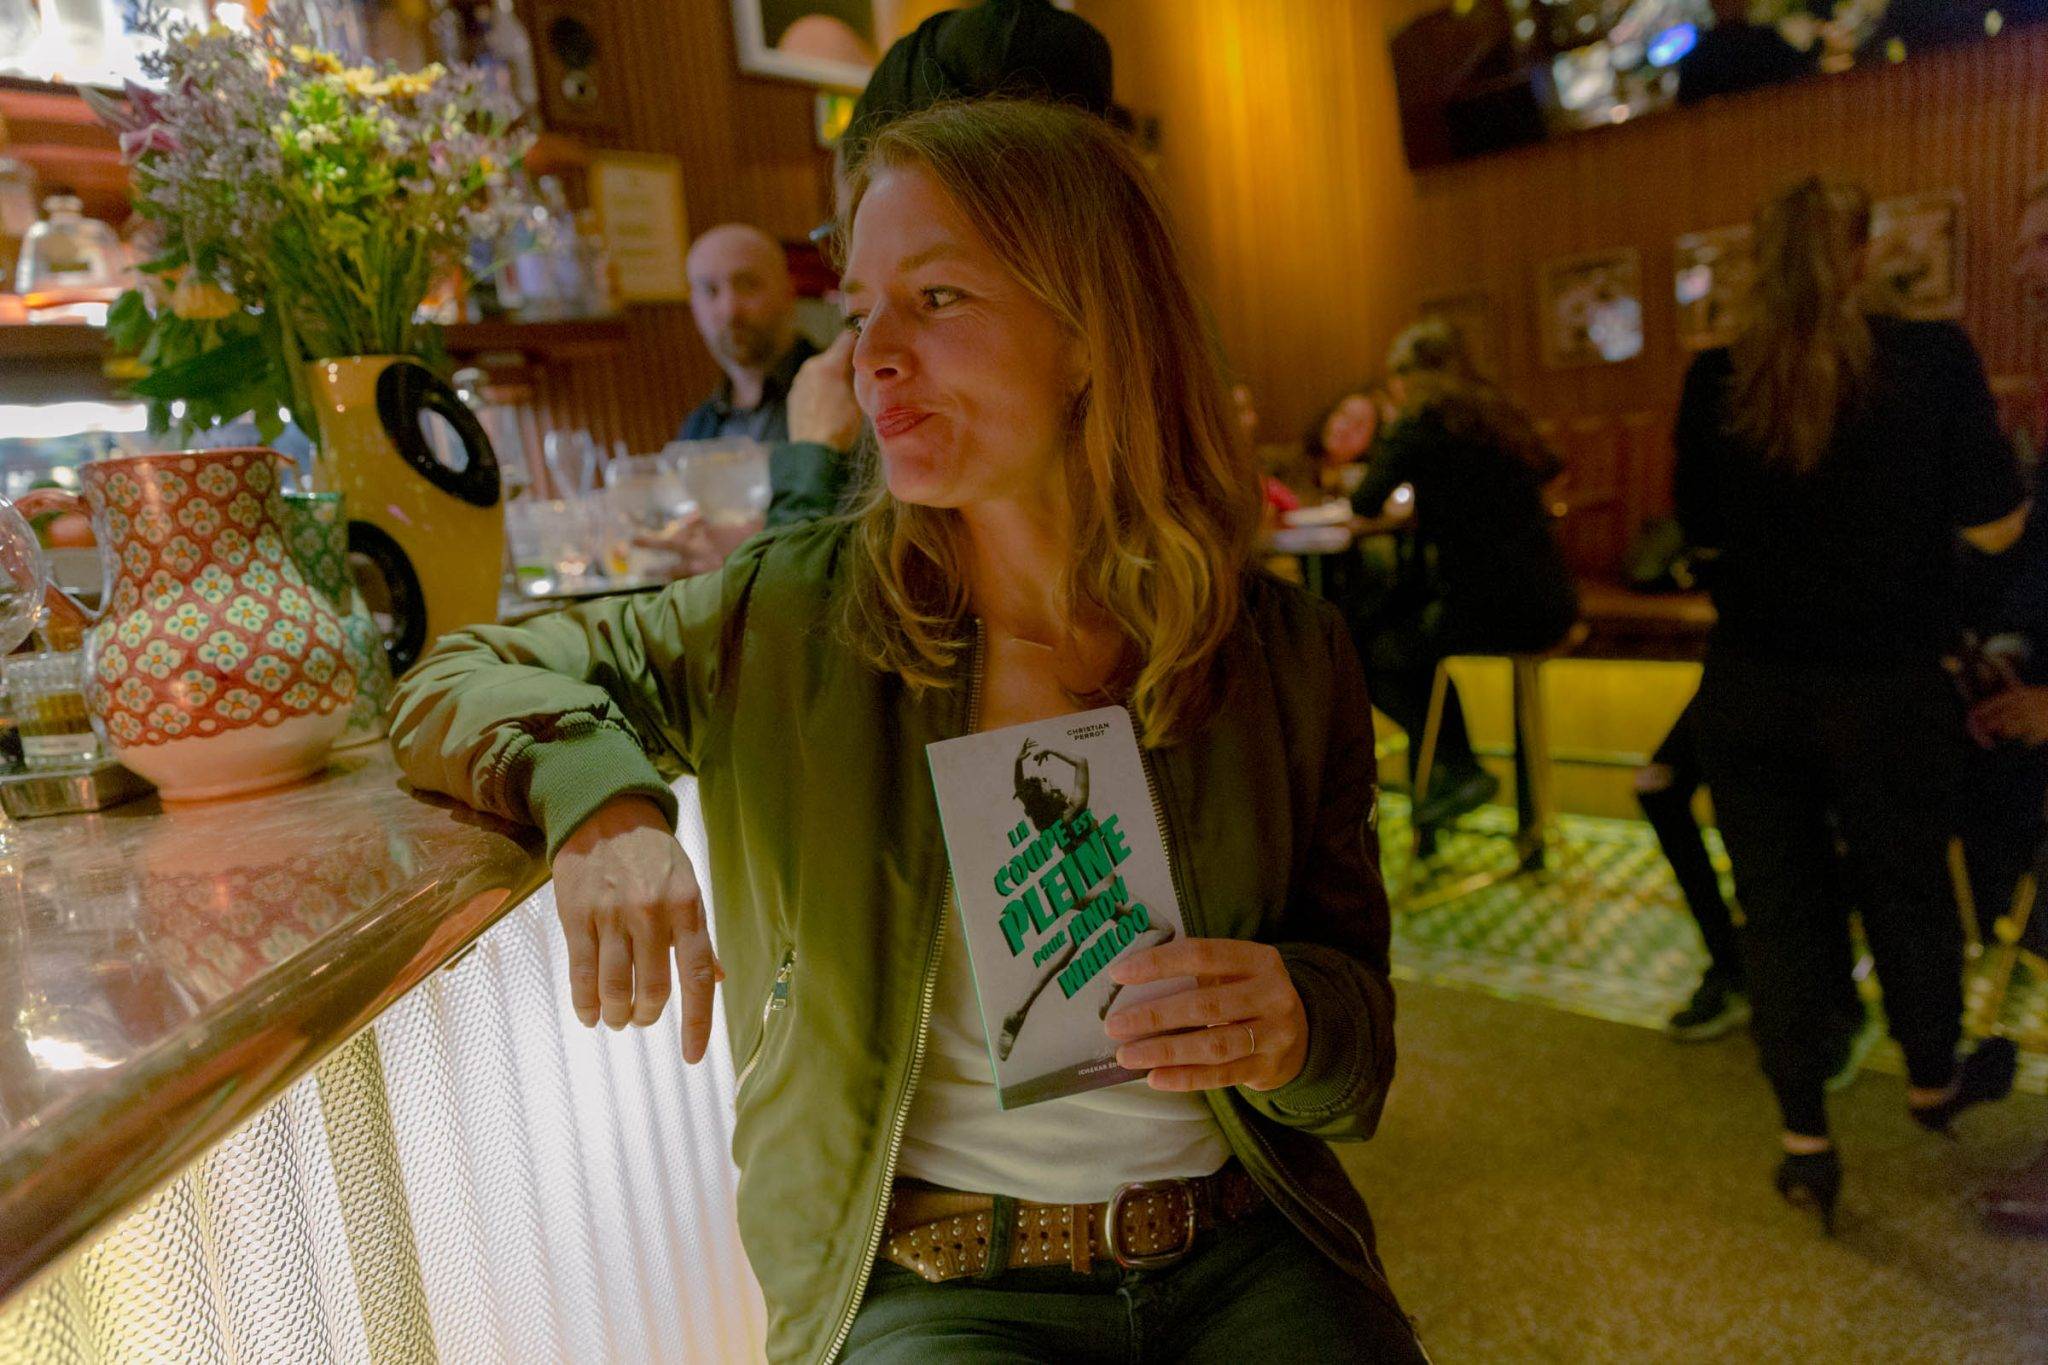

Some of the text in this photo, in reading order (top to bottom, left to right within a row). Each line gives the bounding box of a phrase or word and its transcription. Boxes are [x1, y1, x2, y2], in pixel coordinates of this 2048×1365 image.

[1066, 722, 1109, 736] CHRISTIAN
[1074, 730, 1104, 740] PERROT
[994, 808, 1096, 896] COUPE EST
[1007, 820, 1030, 848] LA
[999, 813, 1133, 957] PLEINE
[1033, 875, 1130, 968] POUR ANDY
[1057, 903, 1150, 999] WAHLOO
